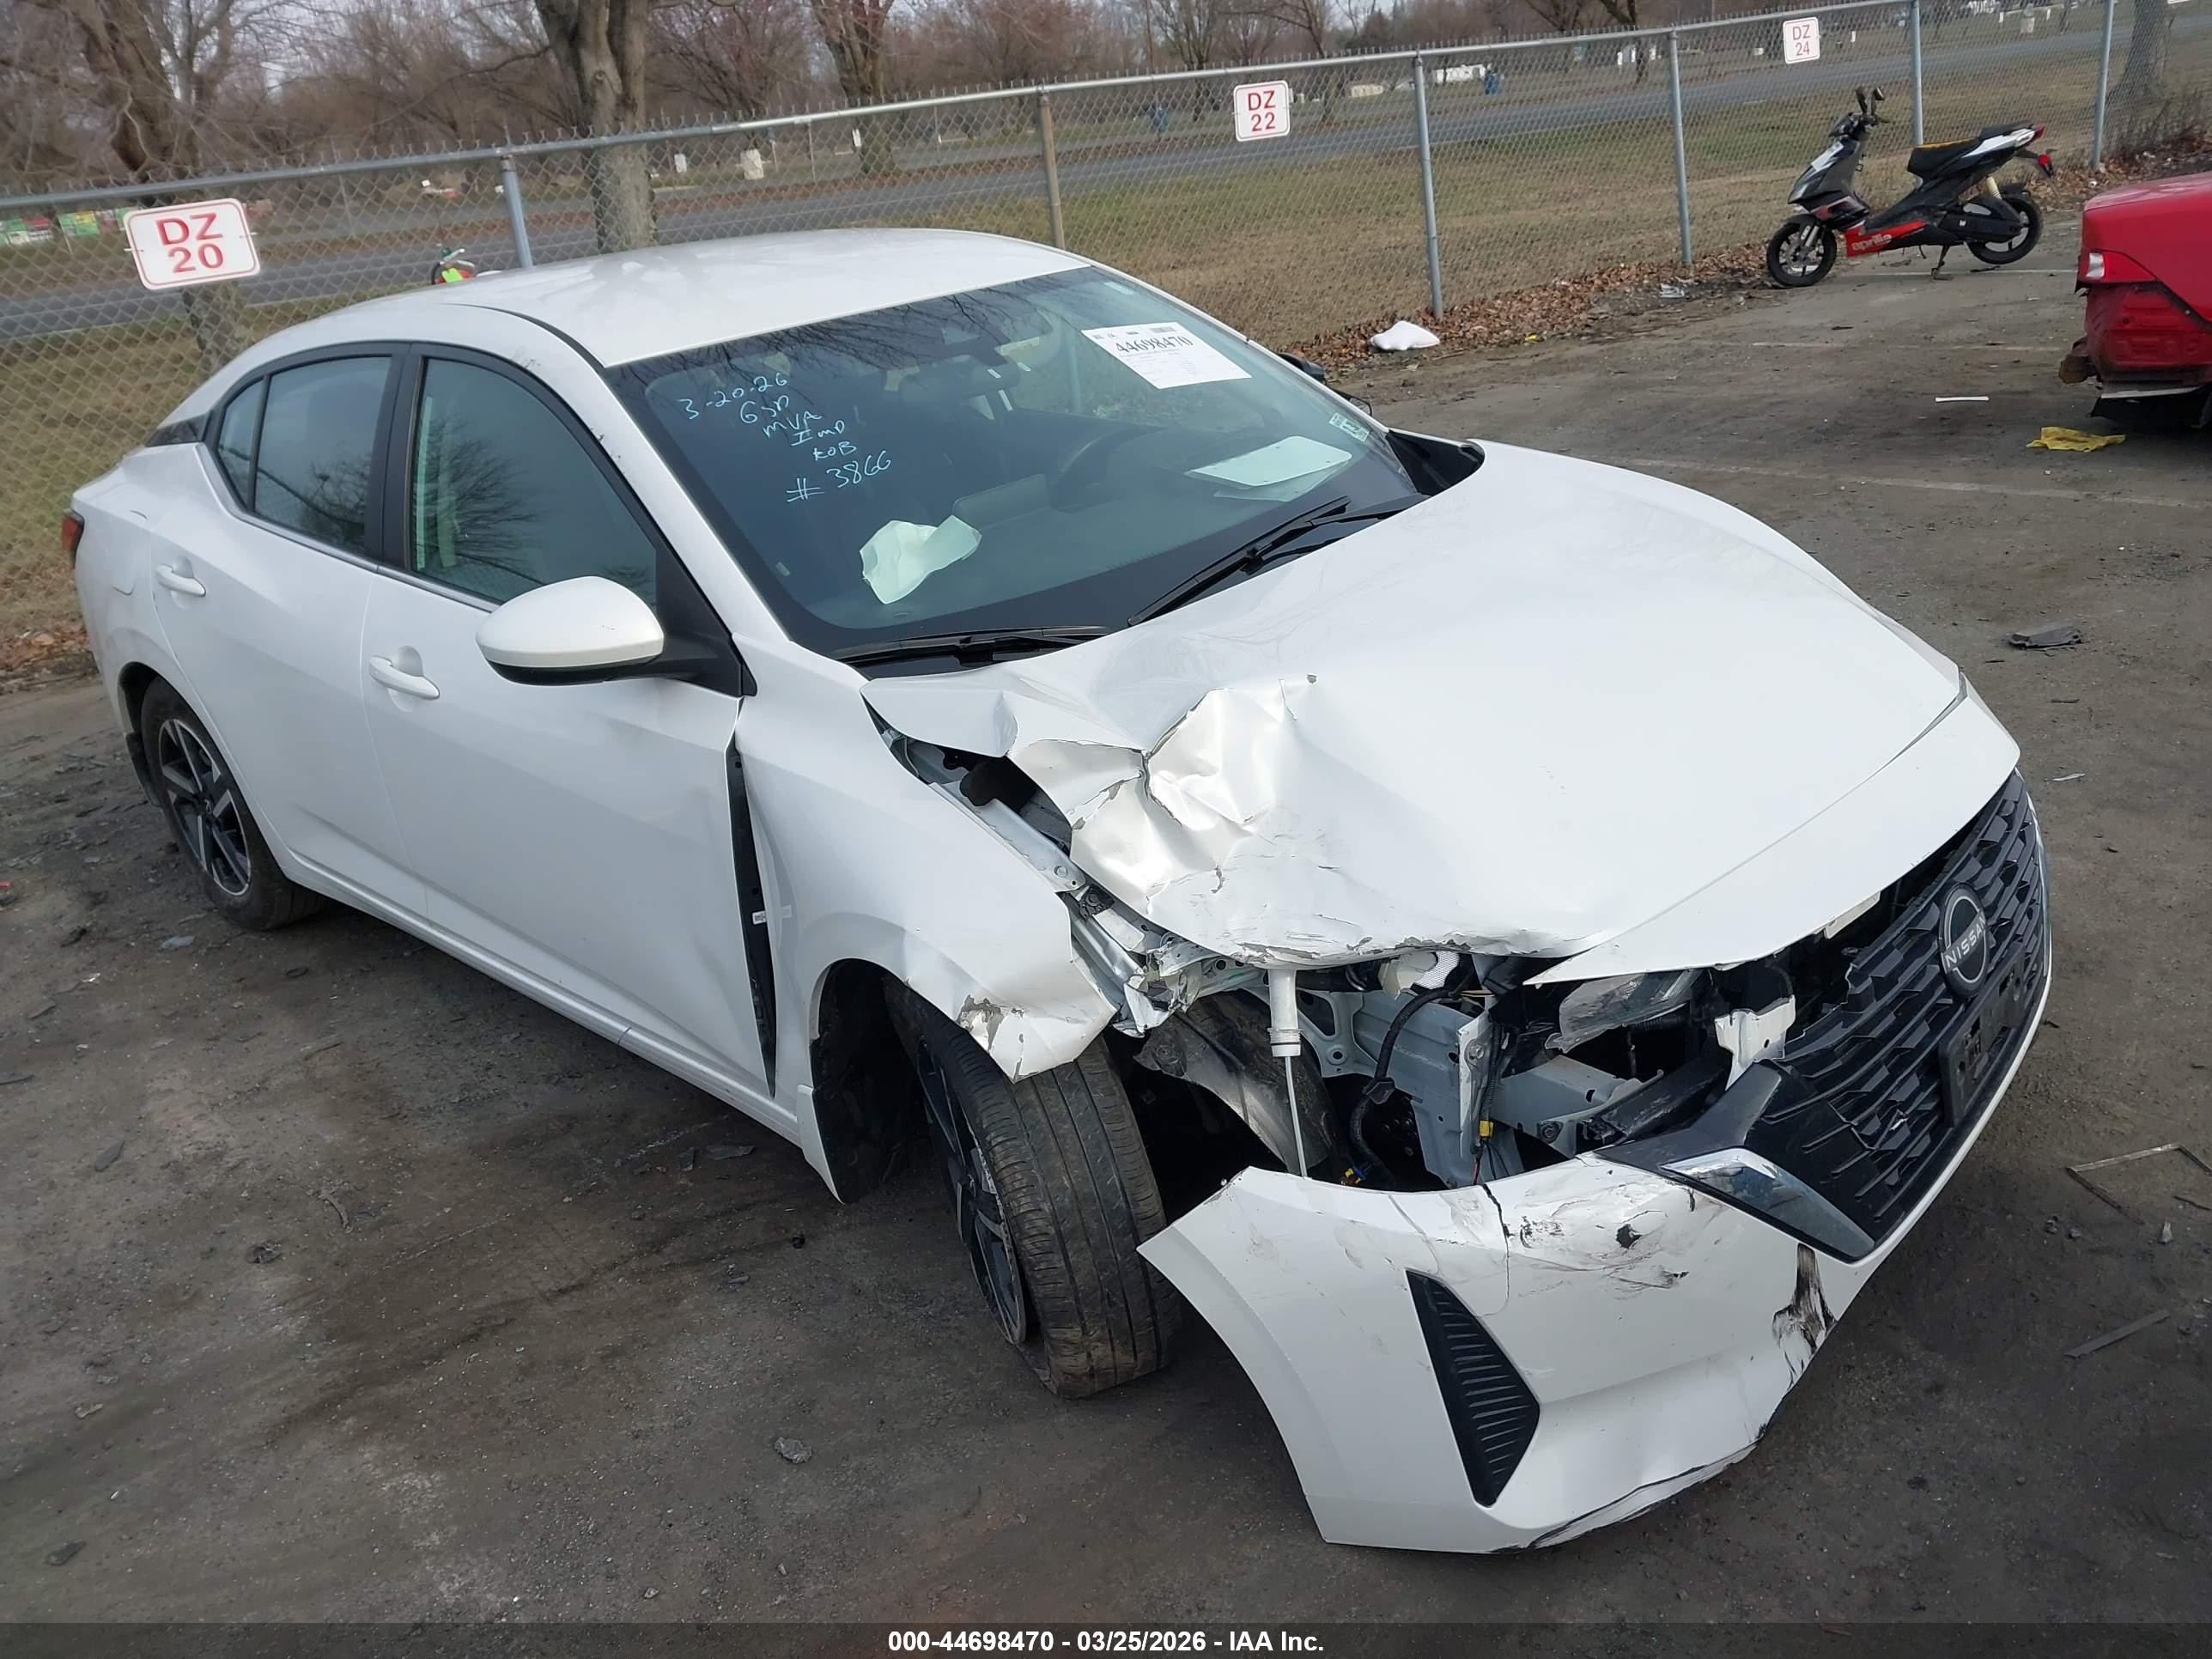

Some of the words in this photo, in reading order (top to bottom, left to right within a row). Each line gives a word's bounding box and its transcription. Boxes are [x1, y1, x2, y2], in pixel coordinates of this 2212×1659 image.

[1792, 24, 1811, 40] DZ
[1795, 41, 1810, 56] 24
[1248, 90, 1276, 111] DZ
[1251, 112, 1276, 131] 22
[155, 213, 223, 246] DZ
[167, 243, 224, 273] 20
[1115, 335, 1194, 354] 44698470
[677, 372, 788, 420] 3-20-26
[1944, 915, 1985, 969] NISSAN
